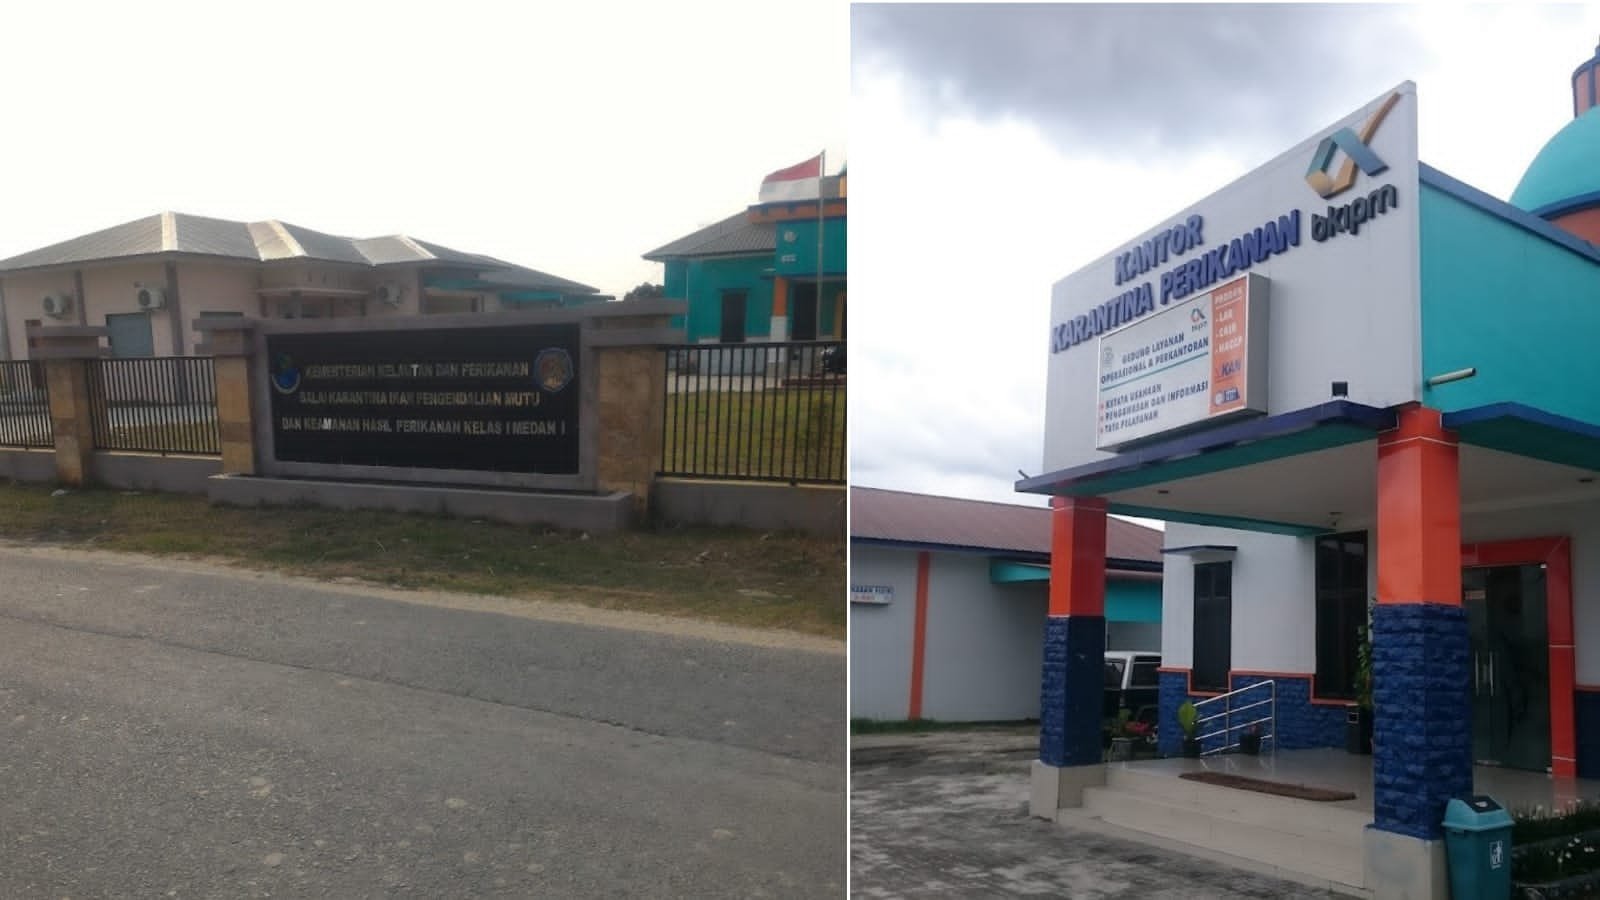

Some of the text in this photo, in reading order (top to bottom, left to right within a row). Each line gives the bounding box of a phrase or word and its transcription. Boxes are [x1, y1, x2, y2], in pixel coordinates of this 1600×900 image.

[1311, 183, 1397, 242] bkipm
[1114, 213, 1204, 286] KANTOR
[1052, 209, 1301, 354] KARANTINA PERIKANAN
[1152, 332, 1184, 352] LAYANAN
[305, 364, 376, 379] KEMENTERIAN
[436, 363, 458, 377] DAN
[462, 361, 529, 377] PERIKANAN
[1100, 361, 1147, 384] OPERASIONAL
[1155, 337, 1209, 366] PERKANTORAN
[329, 391, 387, 405] KARANTINA
[416, 391, 502, 406] PENGENDALIAN
[505, 391, 540, 407] MUTU
[1167, 381, 1209, 402] INFORMASI
[281, 416, 302, 430] DAN
[304, 416, 360, 431] KEAMANAN
[362, 417, 392, 432] HASIL
[396, 418, 460, 433] PERIKANAN
[464, 419, 502, 435] KELAS
[512, 420, 556, 436] MEDAN
